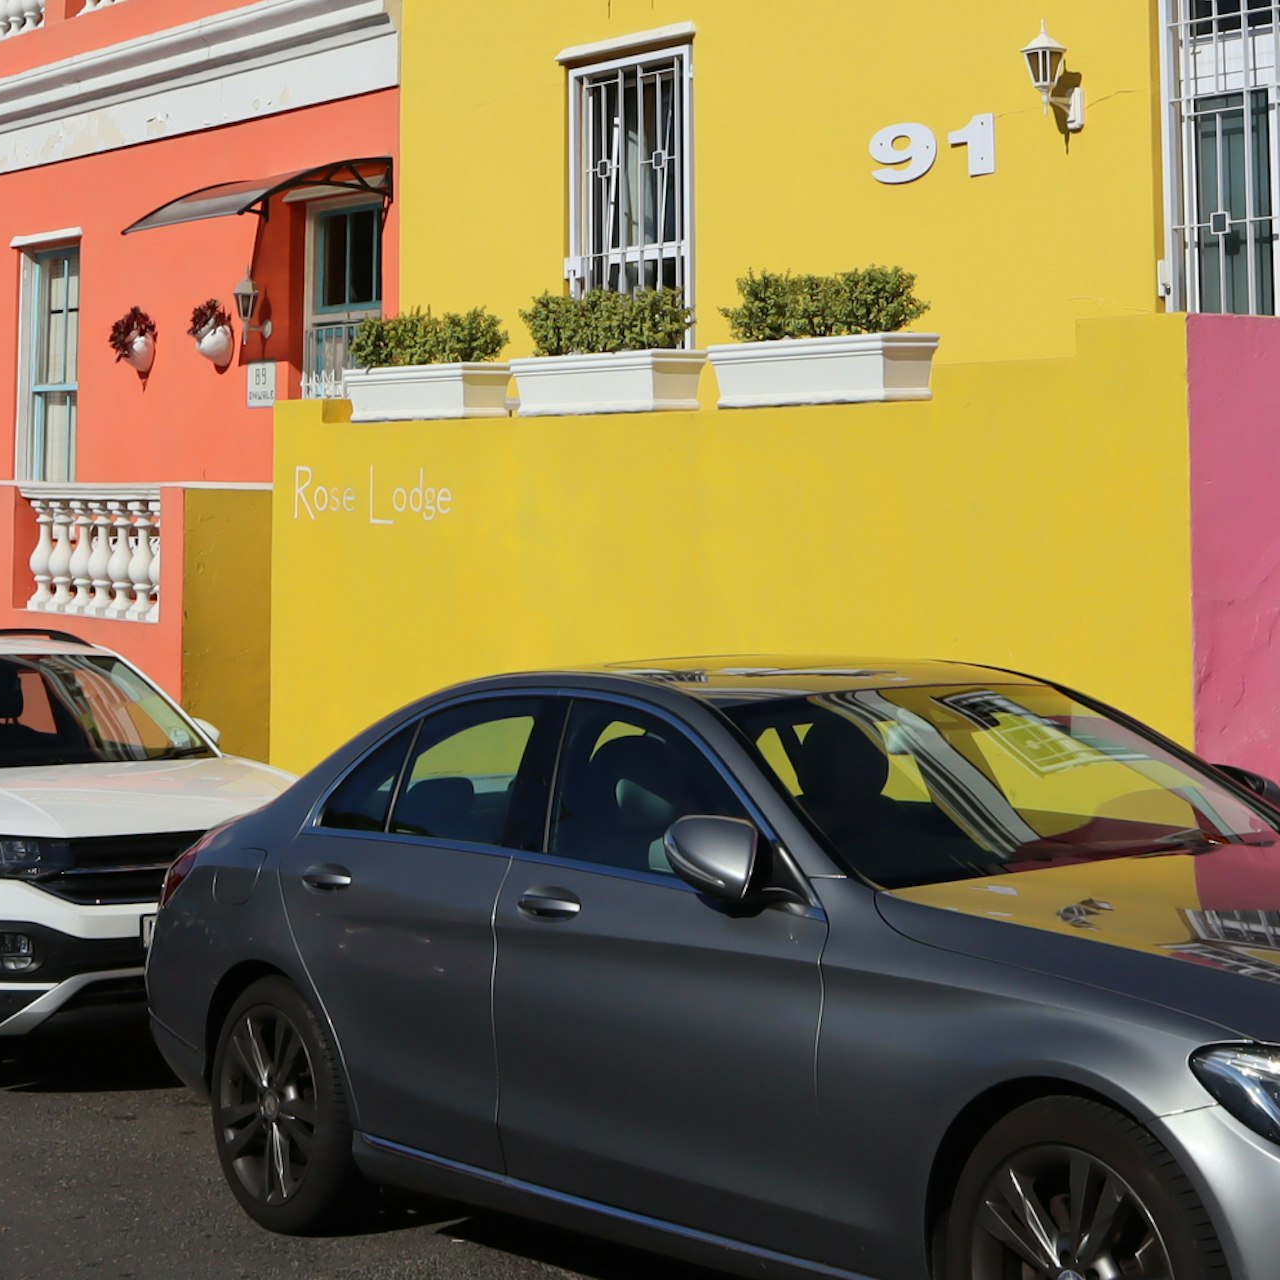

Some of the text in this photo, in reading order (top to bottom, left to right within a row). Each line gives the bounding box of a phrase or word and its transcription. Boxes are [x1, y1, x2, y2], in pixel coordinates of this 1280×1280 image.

[868, 112, 996, 185] 91
[255, 367, 267, 386] 89
[293, 464, 453, 525] Rose Lodge
